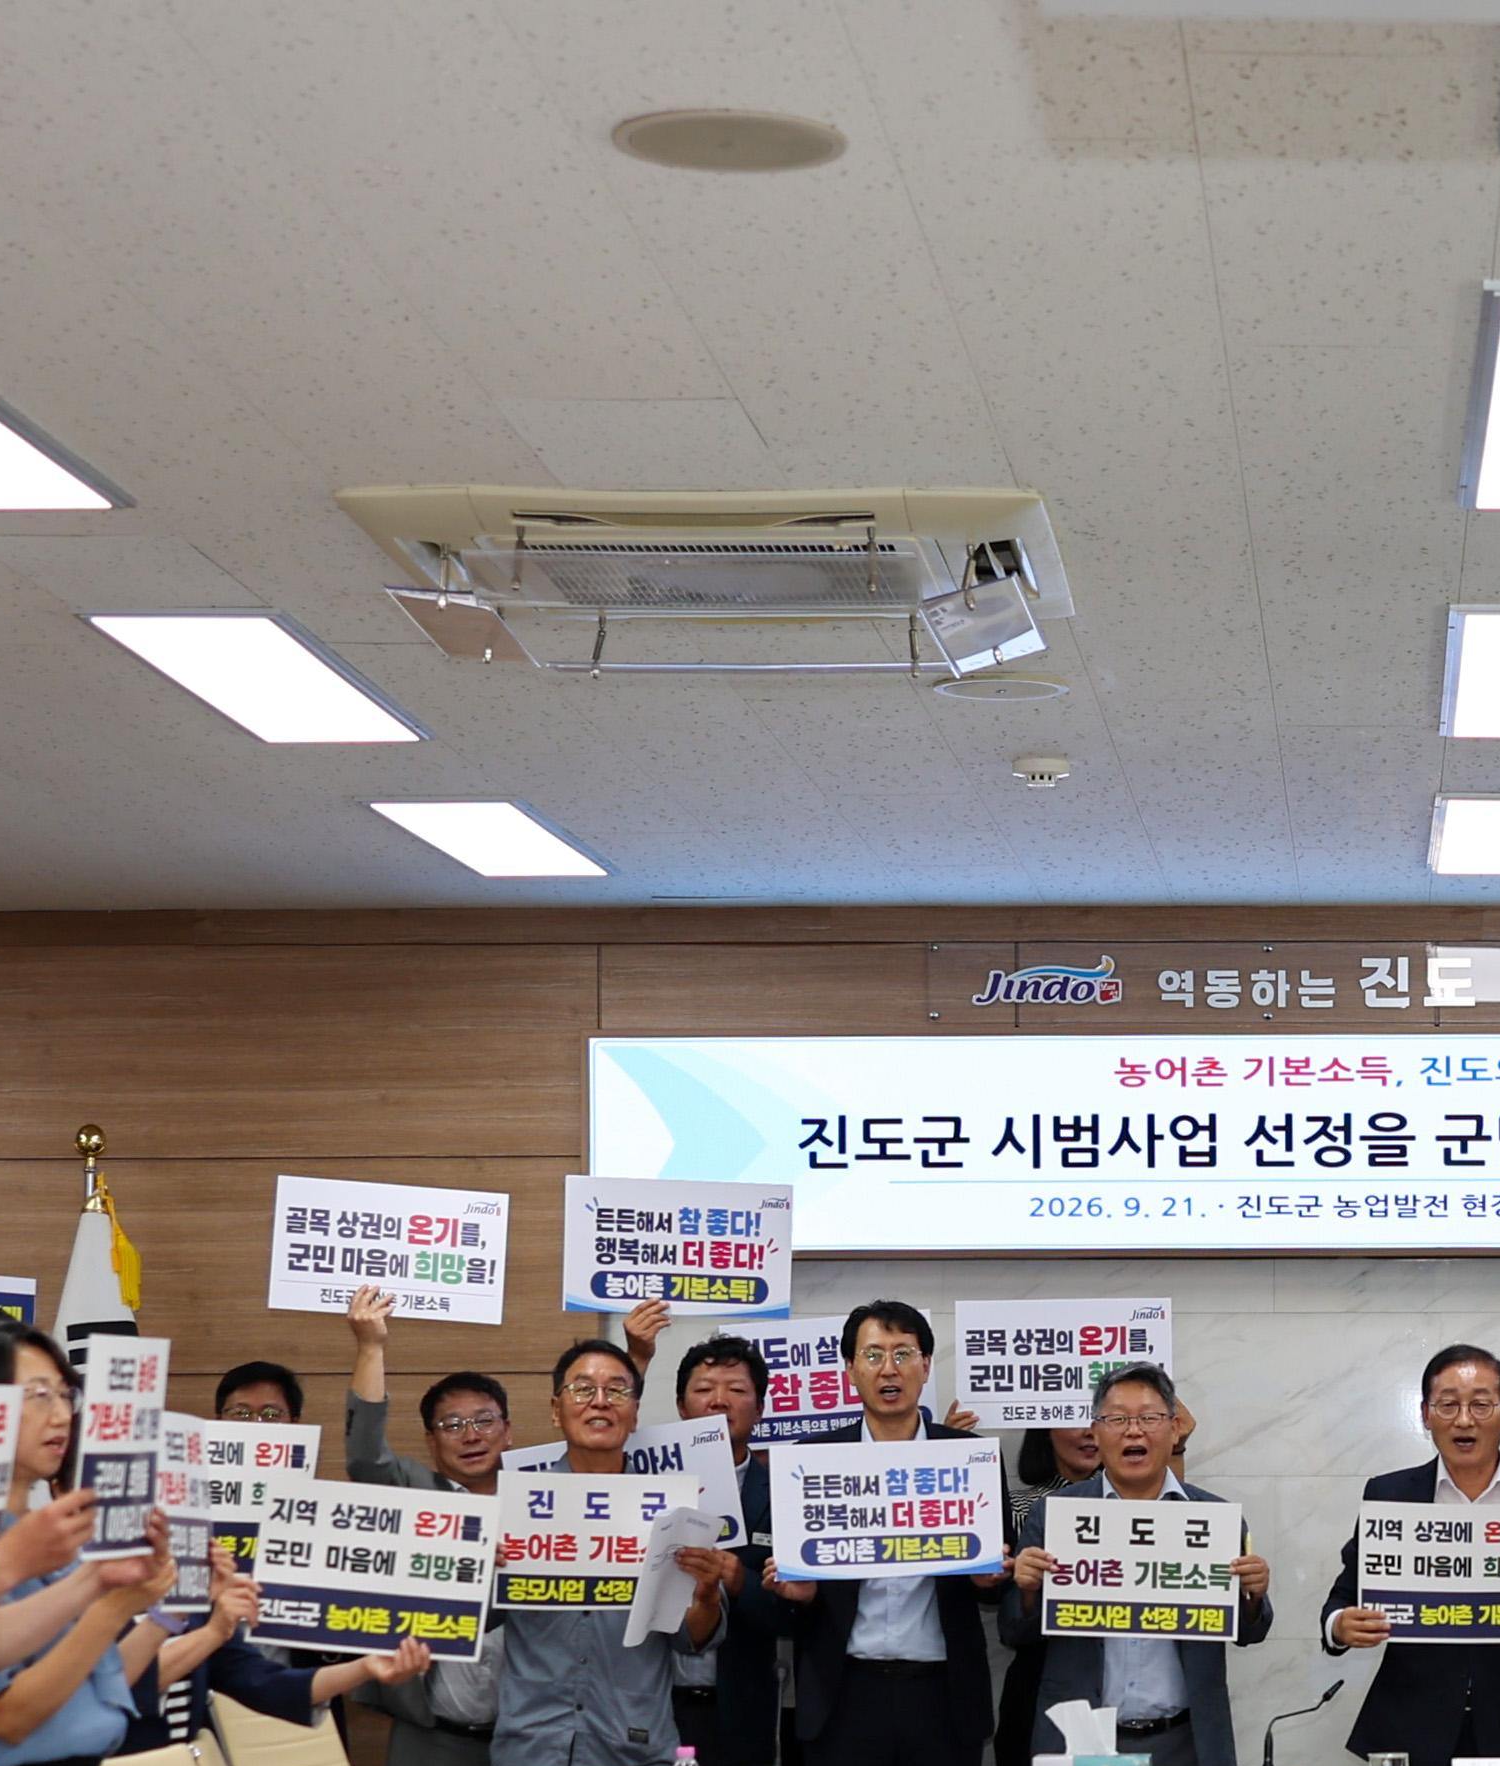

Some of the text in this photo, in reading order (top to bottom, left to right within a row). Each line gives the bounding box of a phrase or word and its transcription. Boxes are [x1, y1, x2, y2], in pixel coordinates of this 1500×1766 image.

[972, 969, 1096, 1005] Jindo
[1158, 969, 1336, 1009] 역동하는
[1360, 956, 1479, 1009] 진도
[1114, 1056, 1229, 1088] 농어촌
[1243, 1056, 1403, 1089] 기본소득,
[798, 1114, 970, 1169] 진도군
[992, 1114, 1218, 1169] 시범사업
[1244, 1112, 1416, 1168] 선정을
[463, 1202, 495, 1215] Jindo
[1029, 1196, 1113, 1218] 2026.
[1124, 1196, 1150, 1218] 9.
[1236, 1195, 1324, 1219] 진도군
[1333, 1193, 1450, 1221] 농업발전
[286, 1207, 486, 1250] 골목 상권의 온기를,
[596, 1207, 761, 1237] 든든해서 참 좋다!
[288, 1243, 496, 1285] 군민 마음에 희망을!
[595, 1237, 764, 1270] 행복해서 더 좋다!
[605, 1274, 755, 1301] 농어촌 기본소득!
[401, 1294, 450, 1312] 기본소득
[1129, 1309, 1159, 1321] Jindo
[965, 1326, 1153, 1355] 골목 상권의 온기를,
[970, 1365, 1014, 1392] 군민
[1020, 1364, 1082, 1392] 마음에
[773, 1419, 828, 1435] 기본소득으로
[1002, 1406, 1037, 1420] 진도군
[1041, 1406, 1074, 1420] 농어촌
[691, 1432, 719, 1446] Jindo
[803, 1467, 969, 1499] 든든해서 참 좋다!
[270, 1498, 488, 1546] 지역 상권에 온기를,
[803, 1500, 974, 1532] 행복해서 더 좋다!
[1365, 1519, 1402, 1541] 지역
[1414, 1521, 1472, 1543] 상권에
[503, 1533, 578, 1561] 농어촌
[816, 1536, 968, 1564] 농어촌 기본소득!
[265, 1540, 312, 1567] 군민
[326, 1546, 396, 1576] 마음에
[408, 1553, 485, 1584] 희망을!
[1051, 1558, 1233, 1591] 농어촌 기본소득
[1365, 1554, 1402, 1576] 군민
[1414, 1556, 1472, 1577] 마음에
[507, 1578, 633, 1602] 공모사업 선정
[258, 1599, 478, 1641] 진도군 농어촌 기본소득
[1056, 1604, 1224, 1632] 공모사업 선정 기원
[1420, 1605, 1473, 1625] 농어촌
